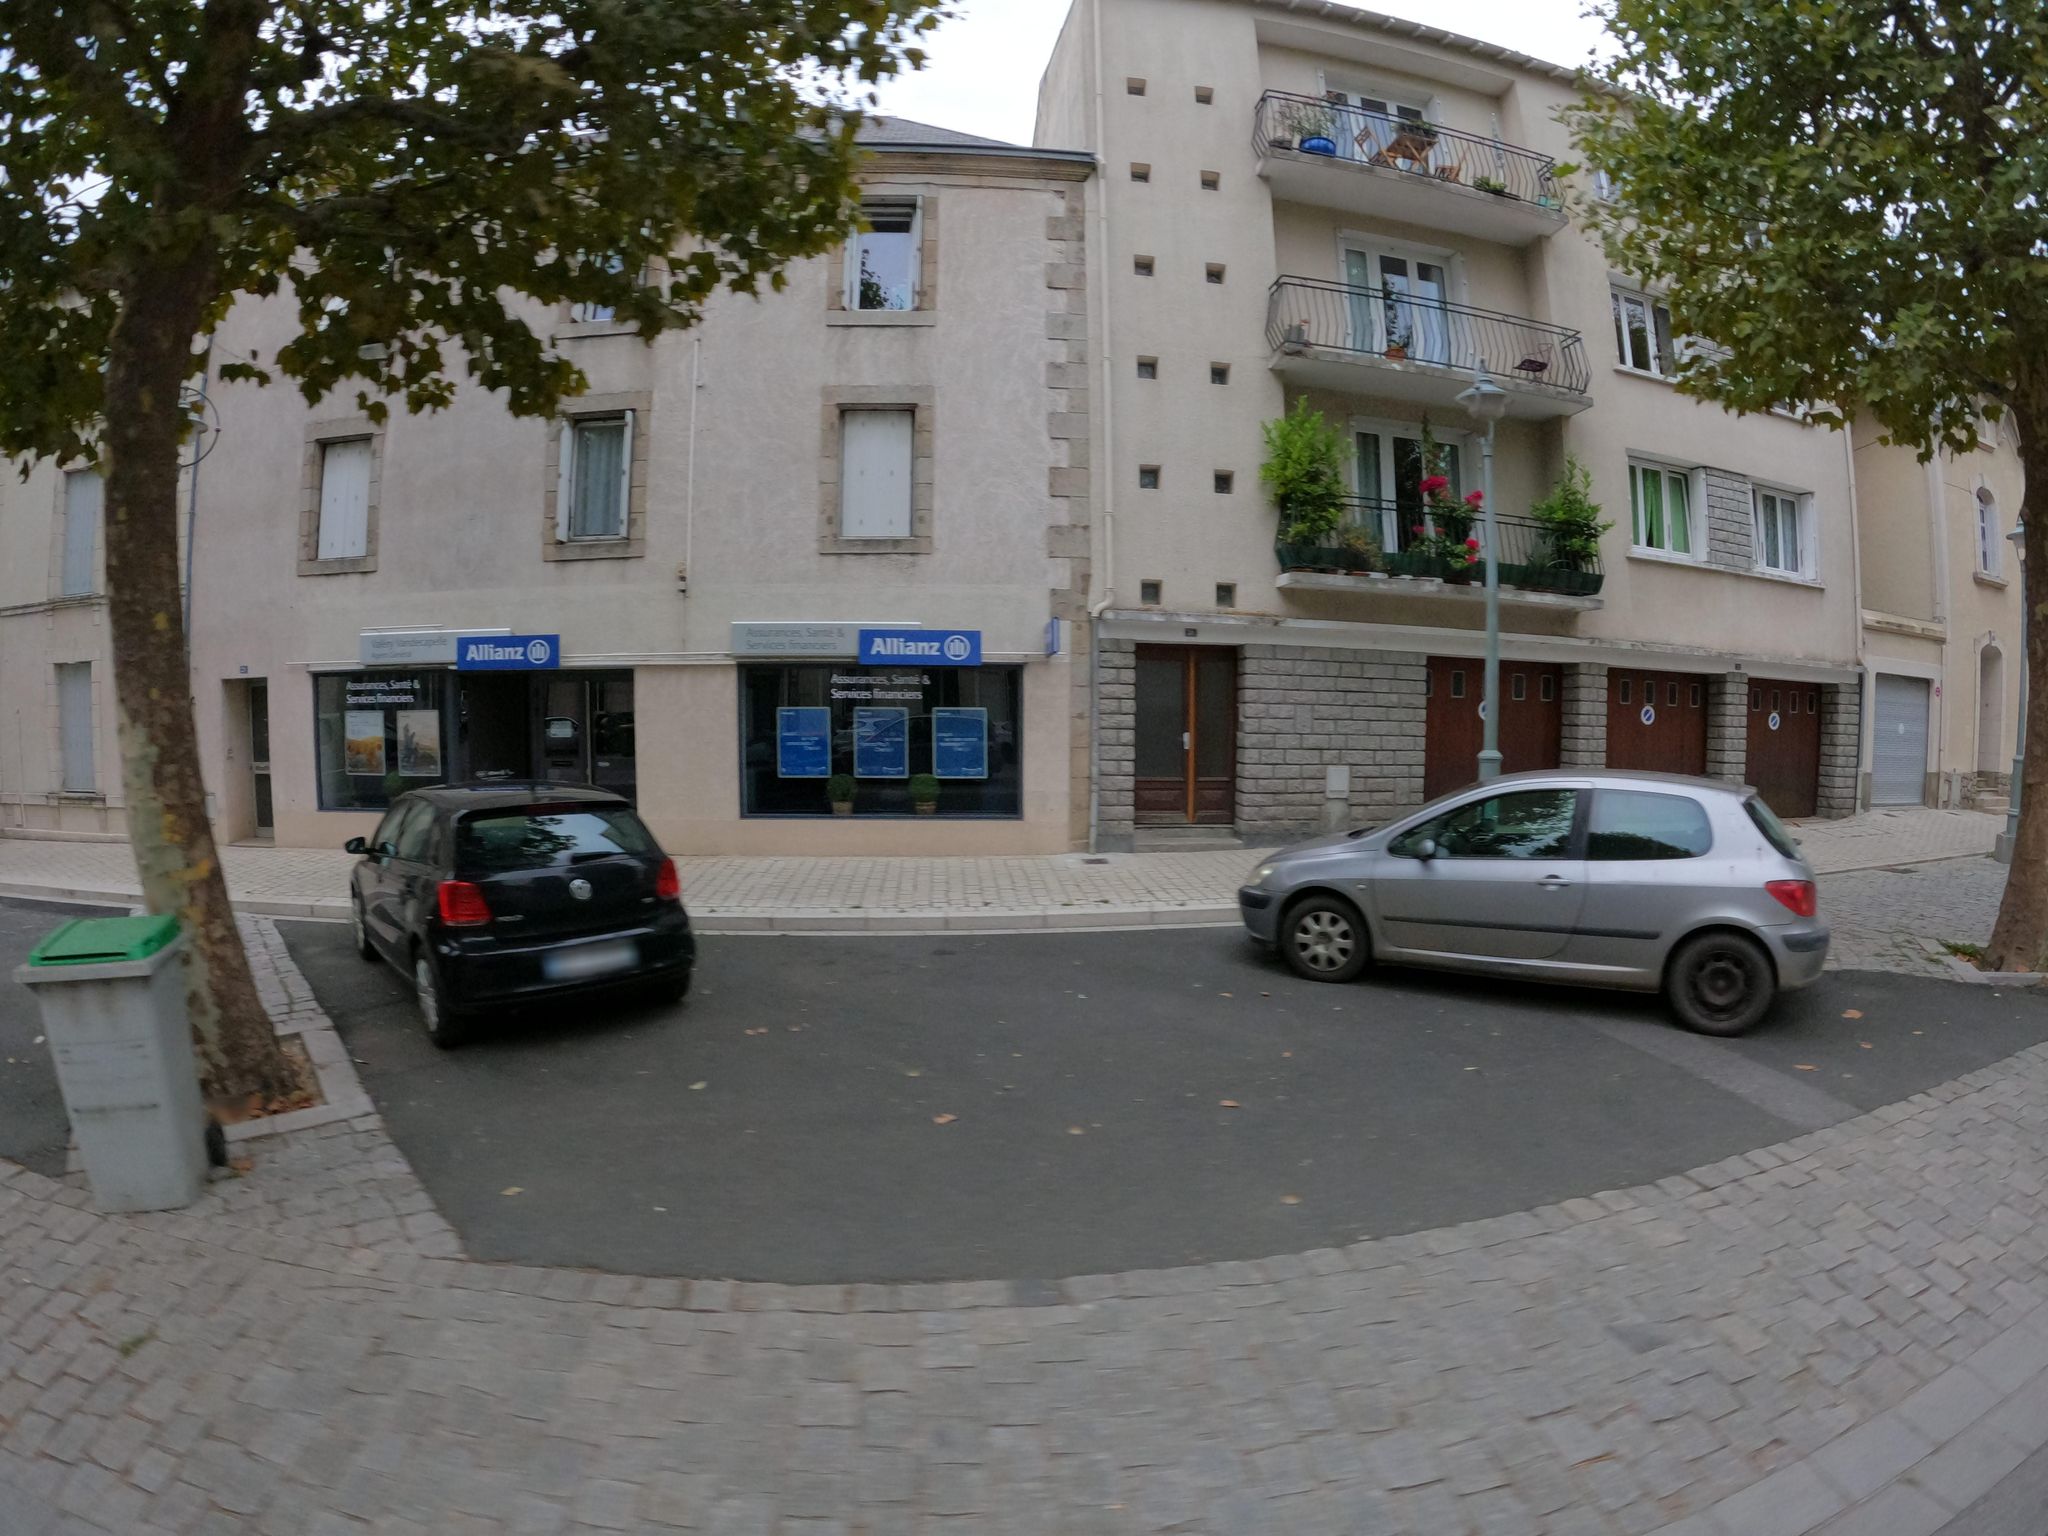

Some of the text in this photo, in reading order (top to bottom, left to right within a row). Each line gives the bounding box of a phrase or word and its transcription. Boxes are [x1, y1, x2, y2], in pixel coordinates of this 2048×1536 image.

[870, 637, 942, 655] Allianz
[466, 644, 524, 661] Allianz
[921, 674, 931, 685] &
[346, 694, 376, 704] Services
[830, 688, 872, 699] Services
